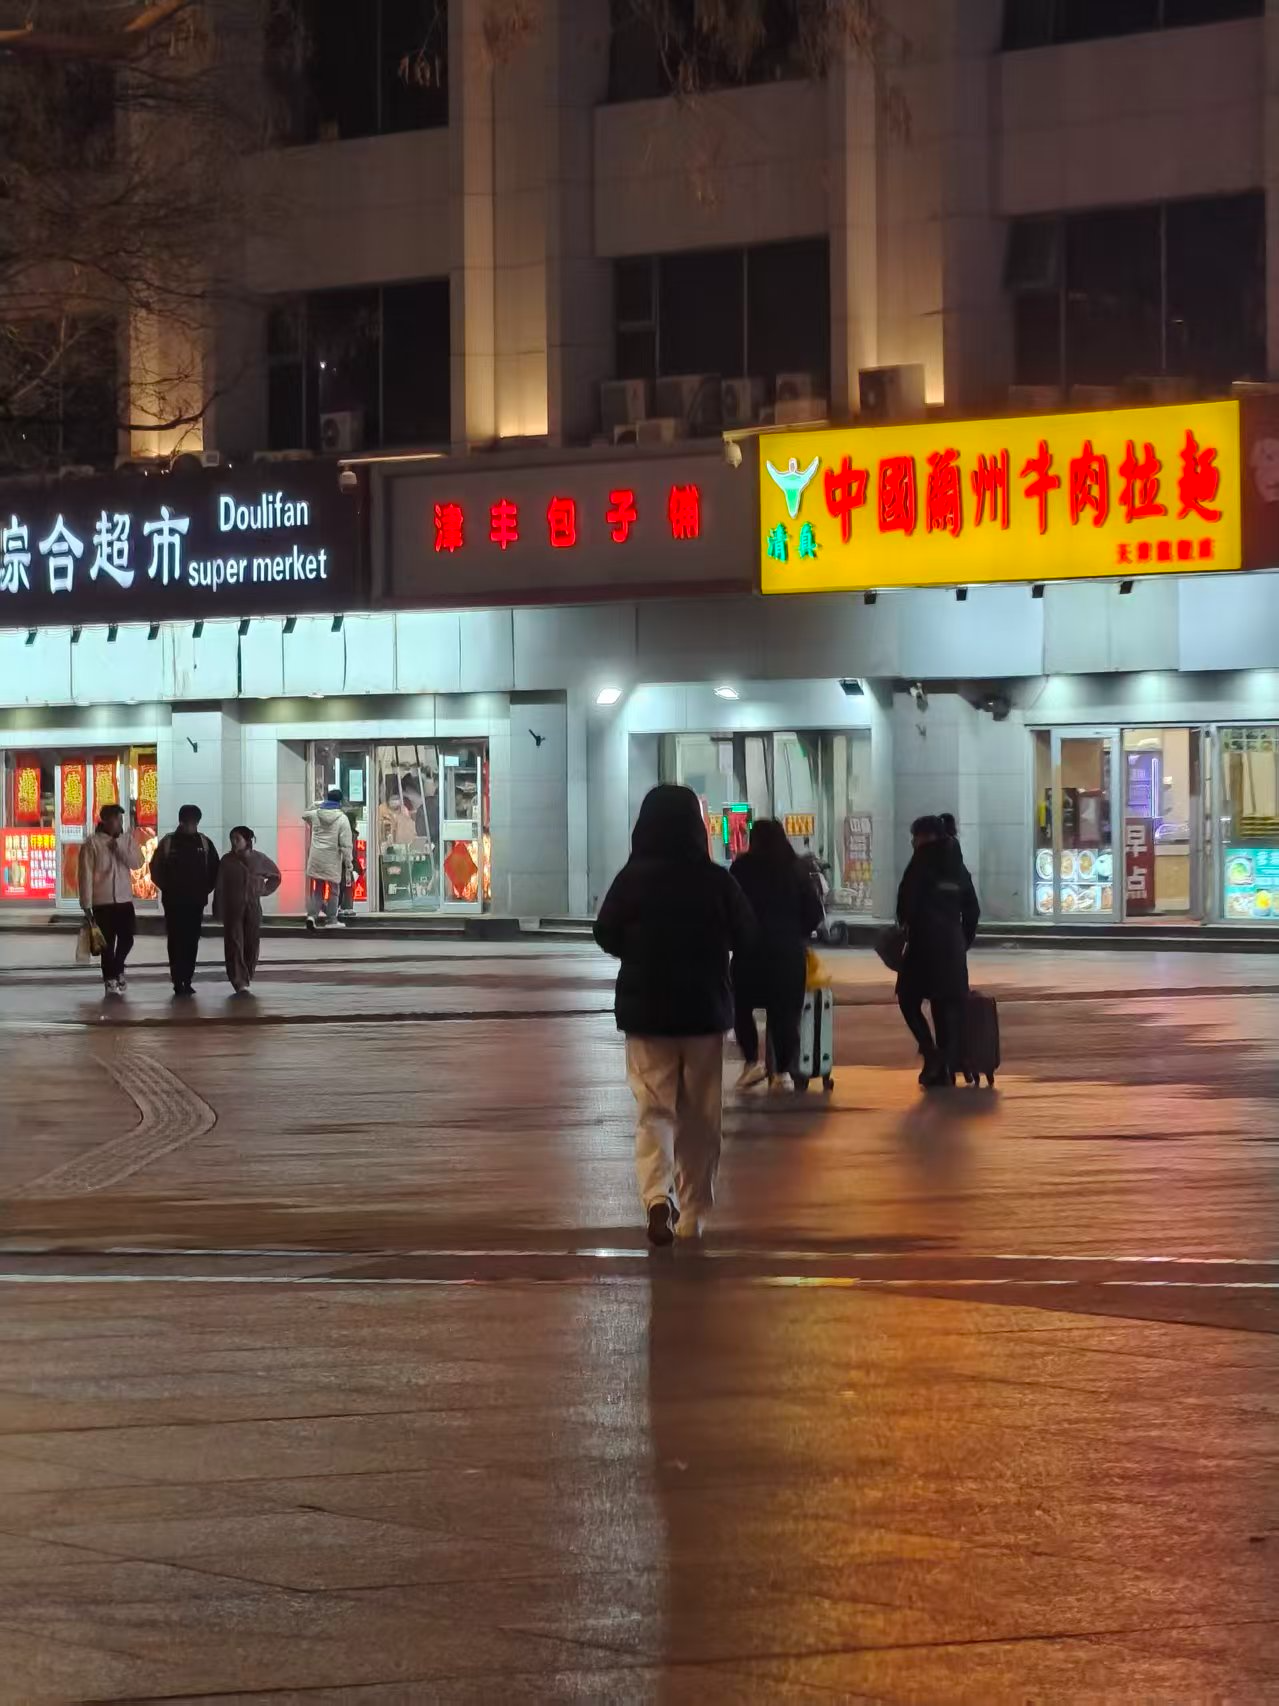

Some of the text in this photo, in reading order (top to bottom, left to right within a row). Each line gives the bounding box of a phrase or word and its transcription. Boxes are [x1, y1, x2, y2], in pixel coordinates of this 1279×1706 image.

[219, 491, 309, 532] Doulifan
[766, 521, 819, 564] 清真
[188, 545, 328, 593] super merket
